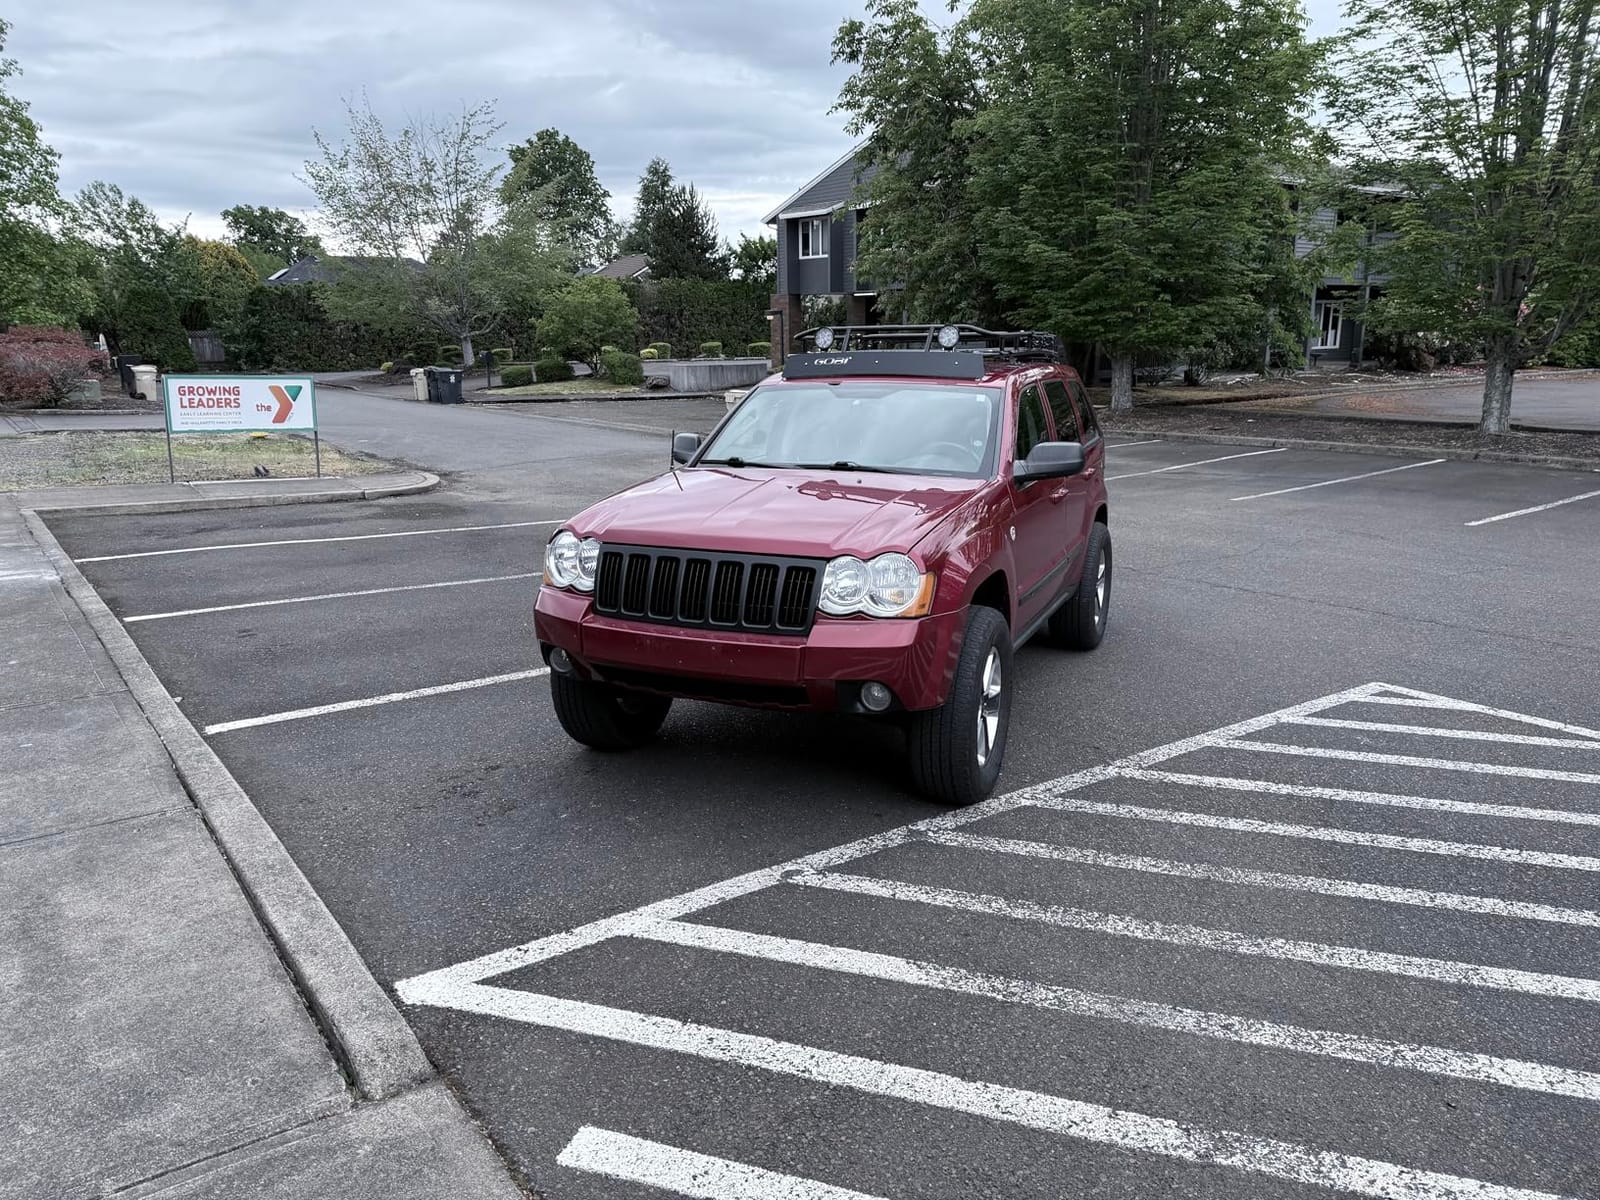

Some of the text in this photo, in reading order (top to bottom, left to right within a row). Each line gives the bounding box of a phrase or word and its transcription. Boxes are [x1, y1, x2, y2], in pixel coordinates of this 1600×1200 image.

[178, 386, 240, 396] GROWING
[180, 397, 241, 408] LEADERS
[256, 403, 272, 412] the
